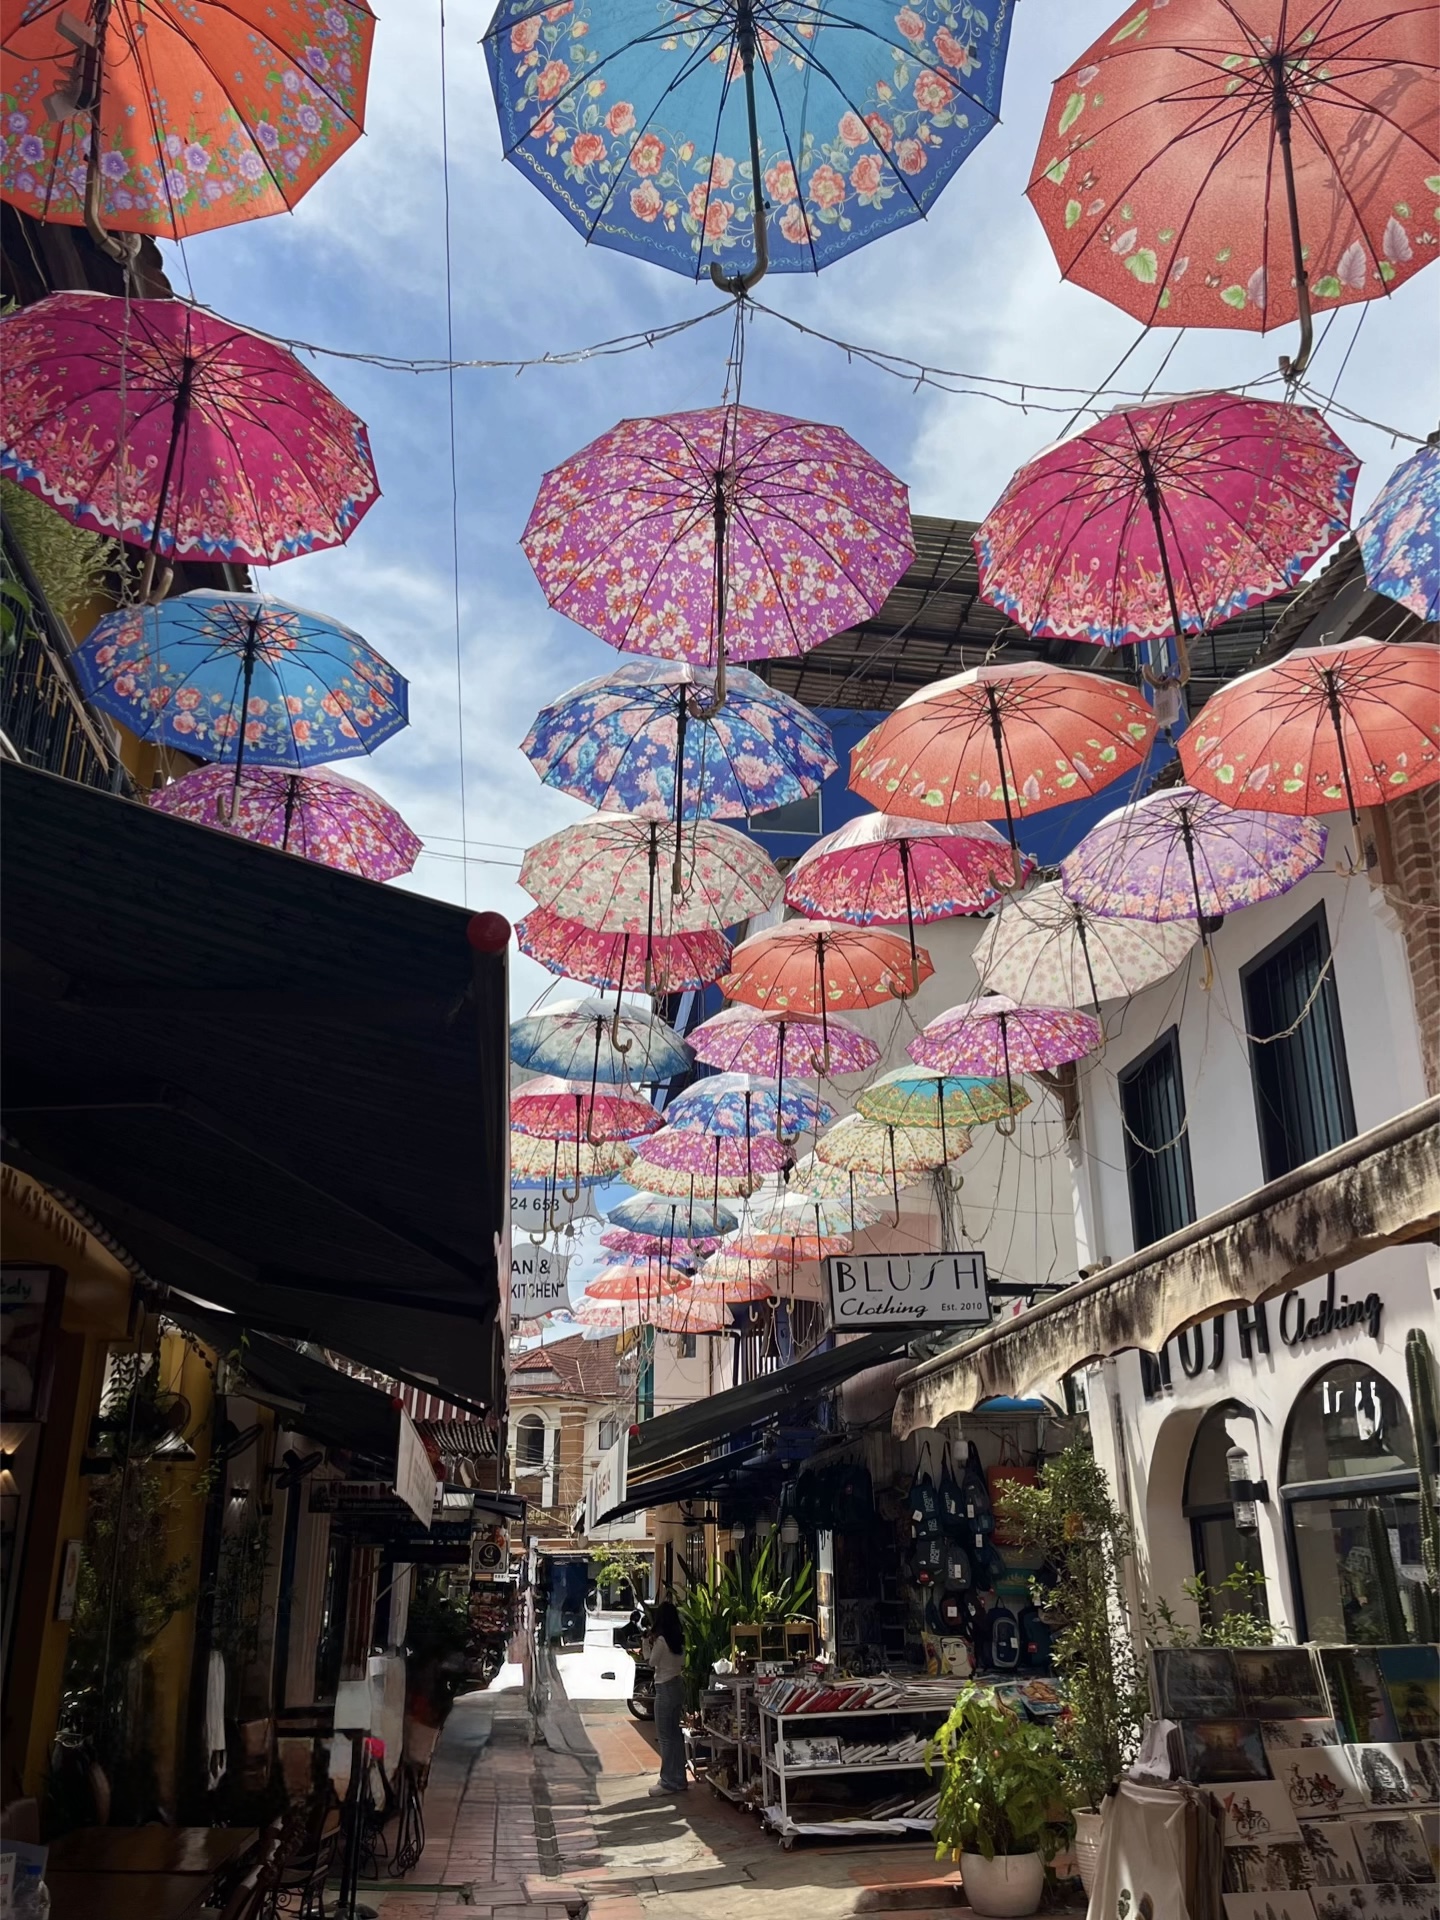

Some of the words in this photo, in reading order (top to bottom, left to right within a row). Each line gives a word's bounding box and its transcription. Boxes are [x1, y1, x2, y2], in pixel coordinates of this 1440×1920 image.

[540, 1259, 551, 1275] &
[836, 1258, 979, 1293] BLUSH
[840, 1295, 928, 1318] Clothing
[941, 1303, 957, 1311] Est.
[960, 1302, 982, 1311] 2010
[1279, 1270, 1384, 1346] Clothing
